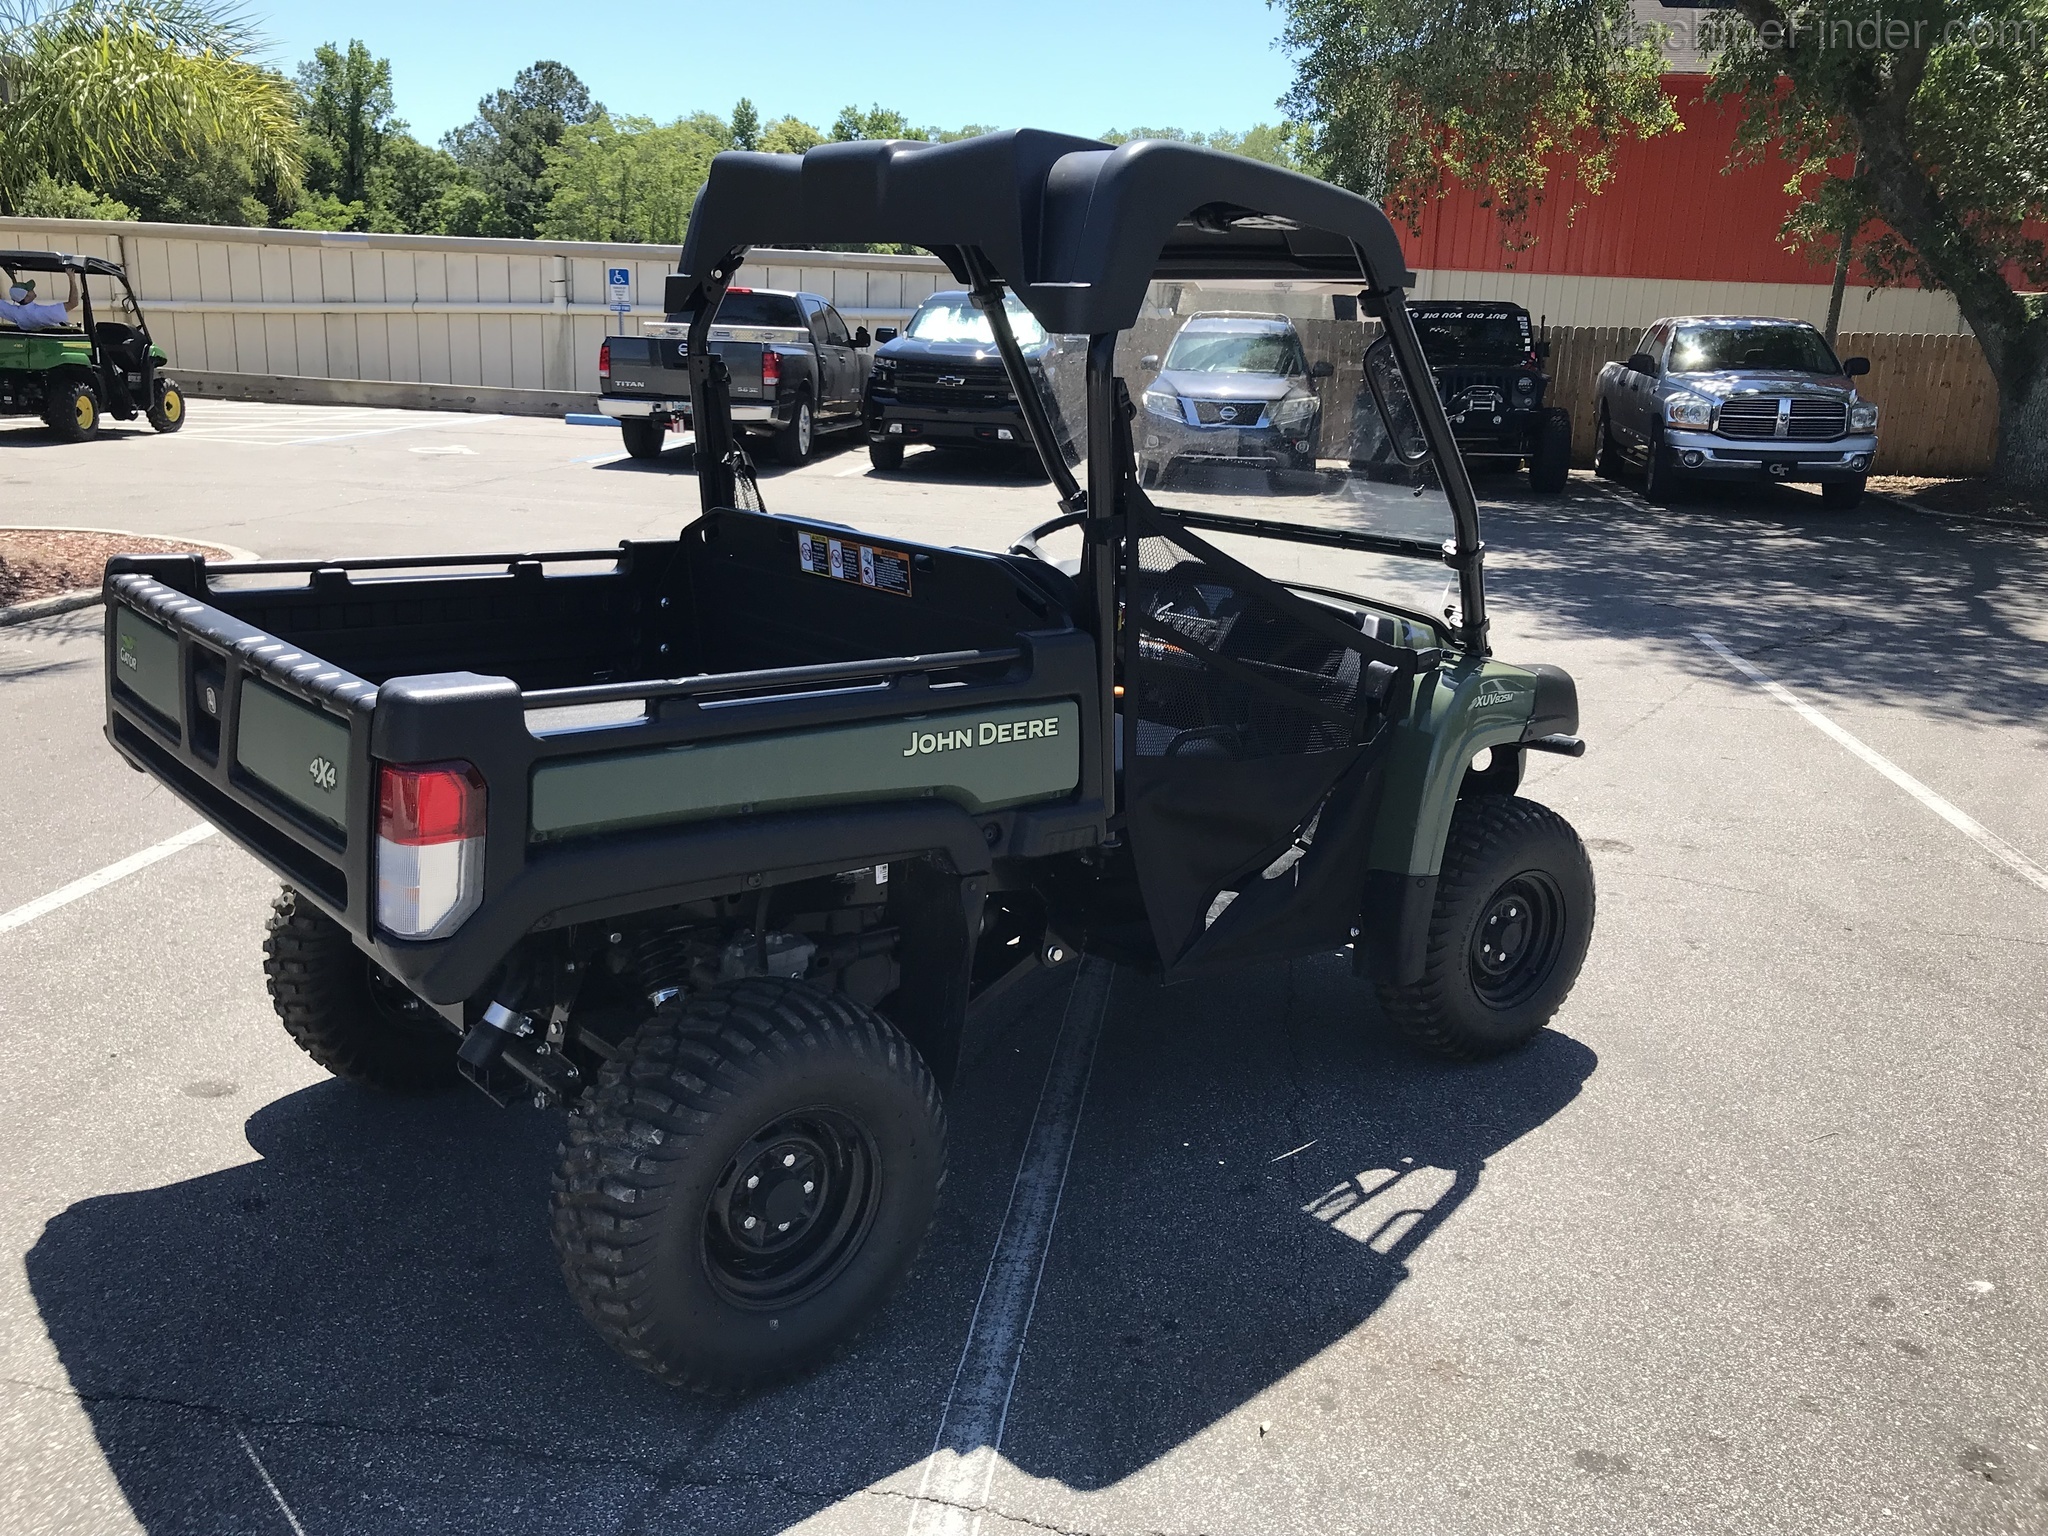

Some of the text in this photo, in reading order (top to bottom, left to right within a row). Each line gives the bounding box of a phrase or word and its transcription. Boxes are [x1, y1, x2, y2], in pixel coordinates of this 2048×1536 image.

[1466, 312, 1485, 320] DID
[614, 380, 645, 388] TITAN
[903, 716, 1059, 757] JOHN DEERE
